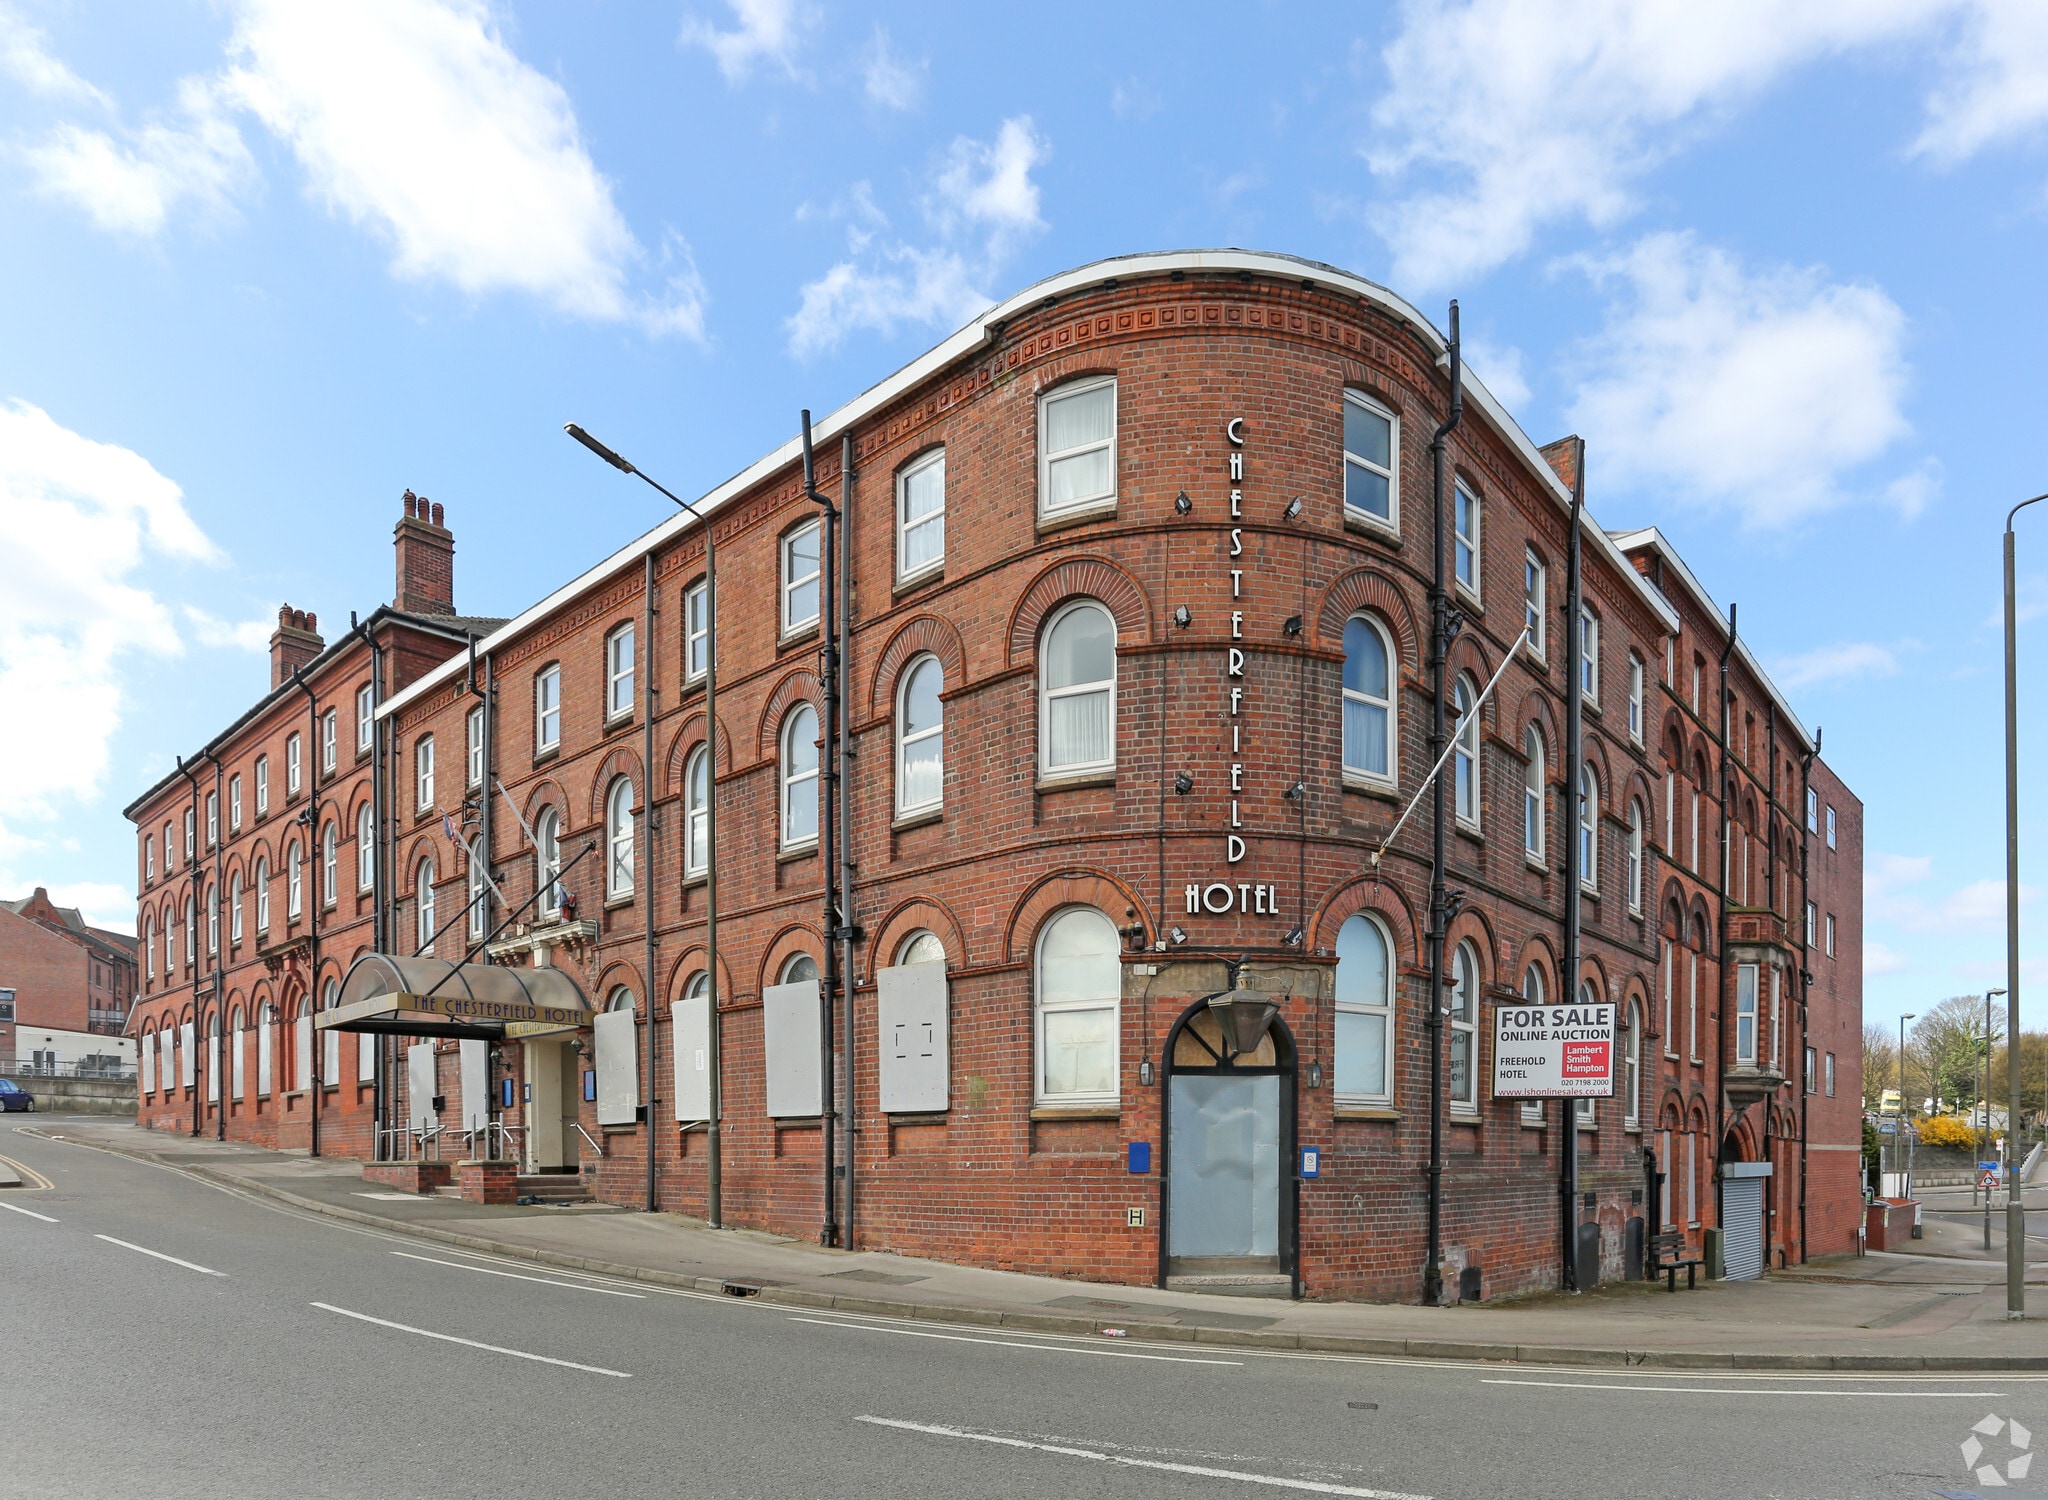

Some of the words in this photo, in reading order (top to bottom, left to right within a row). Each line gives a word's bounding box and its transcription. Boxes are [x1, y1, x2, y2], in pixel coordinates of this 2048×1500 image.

[1226, 417, 1247, 864] CHESTERFIELD
[1185, 883, 1279, 914] HOTEL
[413, 996, 436, 1012] THE
[445, 999, 537, 1021] CHESTERFIELD
[544, 1009, 586, 1025] HOTEL
[1501, 1010, 1545, 1028] FOR
[1551, 1008, 1609, 1027] SALE
[1500, 1031, 1548, 1042] ONLINE
[1551, 1029, 1610, 1041] AUCTION
[1567, 1045, 1603, 1055] Lambert
[1500, 1056, 1546, 1066] FREEHOLD
[1566, 1055, 1591, 1064] Smith
[1499, 1070, 1528, 1079] HOTEL
[1566, 1064, 1604, 1074] Hampton
[1498, 1087, 1609, 1096] www.lshonlinesales.co.uk
[1130, 1209, 1142, 1225] H
